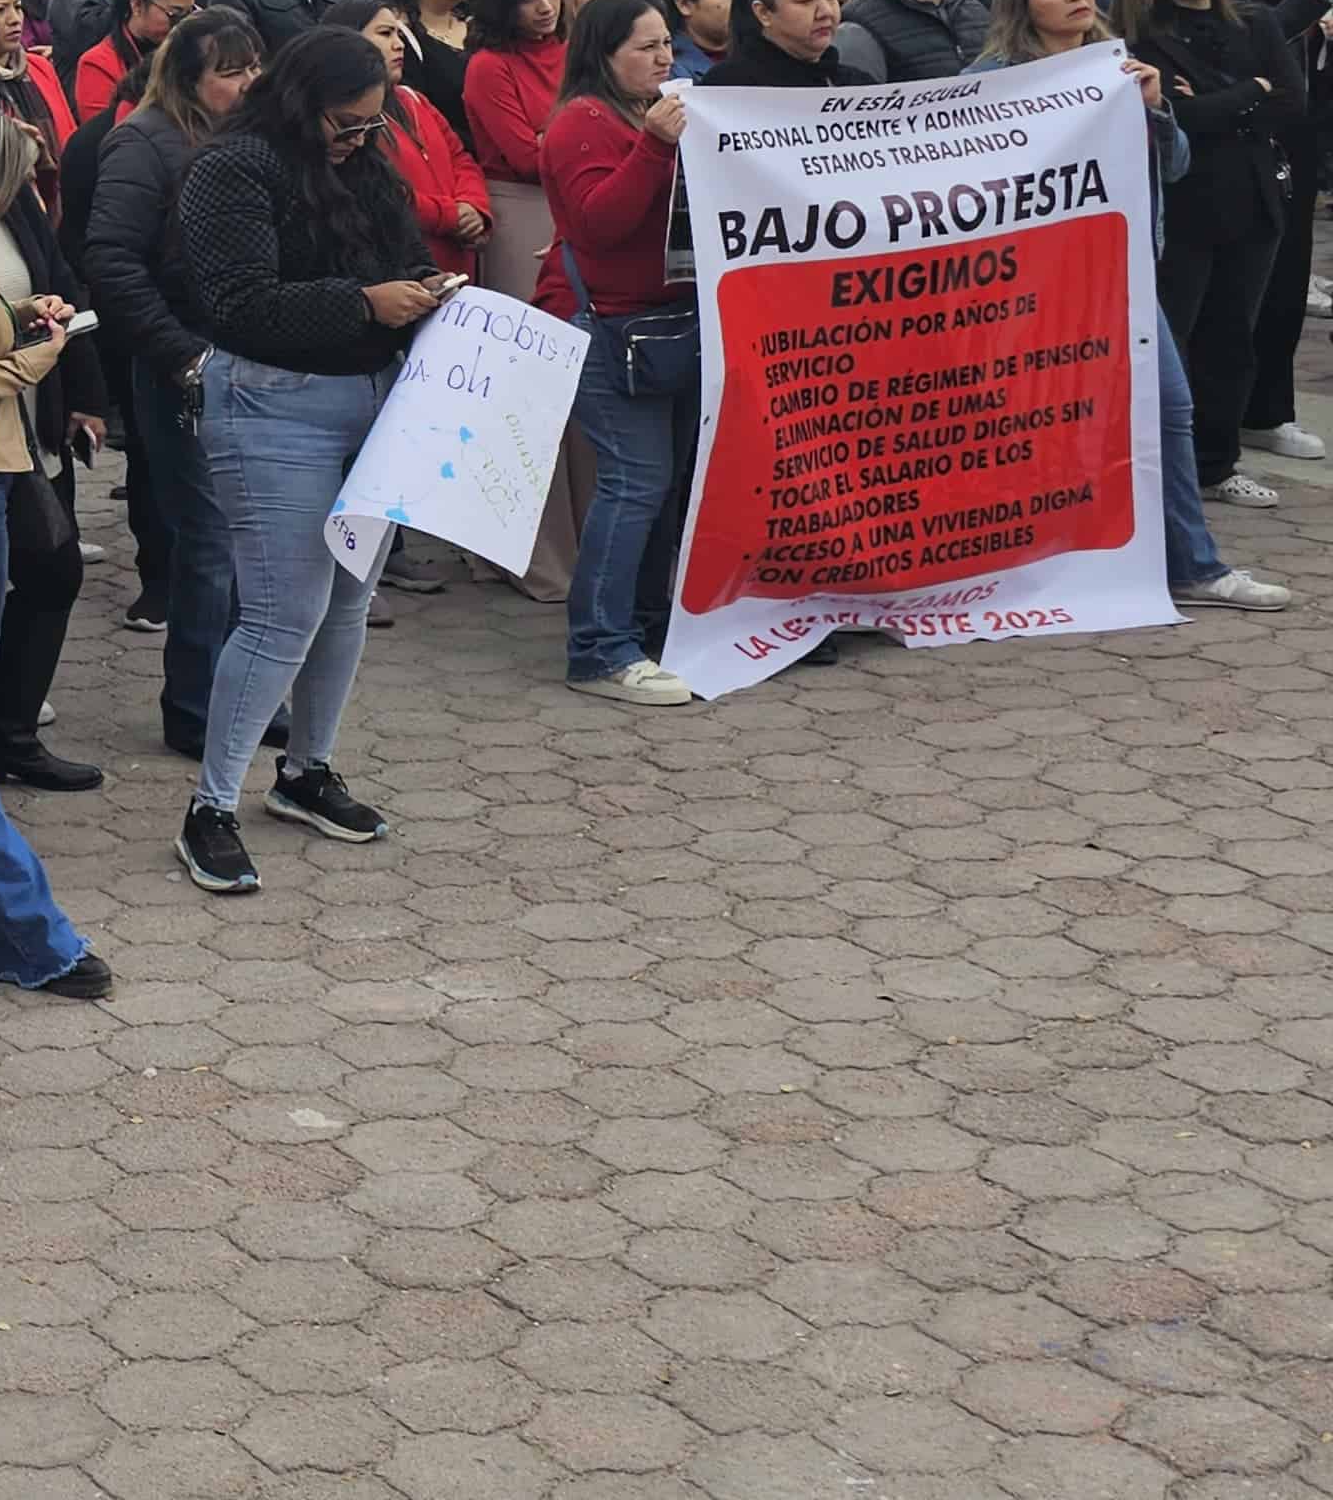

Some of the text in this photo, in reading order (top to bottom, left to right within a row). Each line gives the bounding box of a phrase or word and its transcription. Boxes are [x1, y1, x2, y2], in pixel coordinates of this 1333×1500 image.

[718, 85, 1104, 152] PERSONAL DOCENTE Y ADMINISTRATIVO
[821, 97, 854, 113] EN
[908, 80, 982, 108] ESCUELA
[801, 128, 1029, 176] ESTAMOS TRABAJANDO
[718, 159, 1109, 261] BAJO PROTESTA
[829, 245, 1018, 308] EXIGIMOS
[760, 293, 1037, 358] JUBILACIÓN POR AÑOS DE
[765, 353, 855, 388] SERVICIO
[770, 334, 1110, 419] CAMBIO DE RÉGIMEN DE PENSIÓN
[773, 398, 1094, 481] SERVICIO DE SALUD DIGNOS SIN
[775, 388, 1006, 452] ELIMINACIÓN DE UMAS
[770, 439, 1033, 511] TOCAR EL SALARIO DE LOS
[758, 483, 1094, 562] ACCESO A UNA VIVIENDA DIGNA
[766, 489, 920, 540] TRABAJADORES
[753, 525, 1034, 585] ON CRÉDITOS ACCESIBLES
[733, 635, 781, 661] LA
[874, 612, 976, 637] ISSSTE
[983, 608, 1075, 633] 2025
